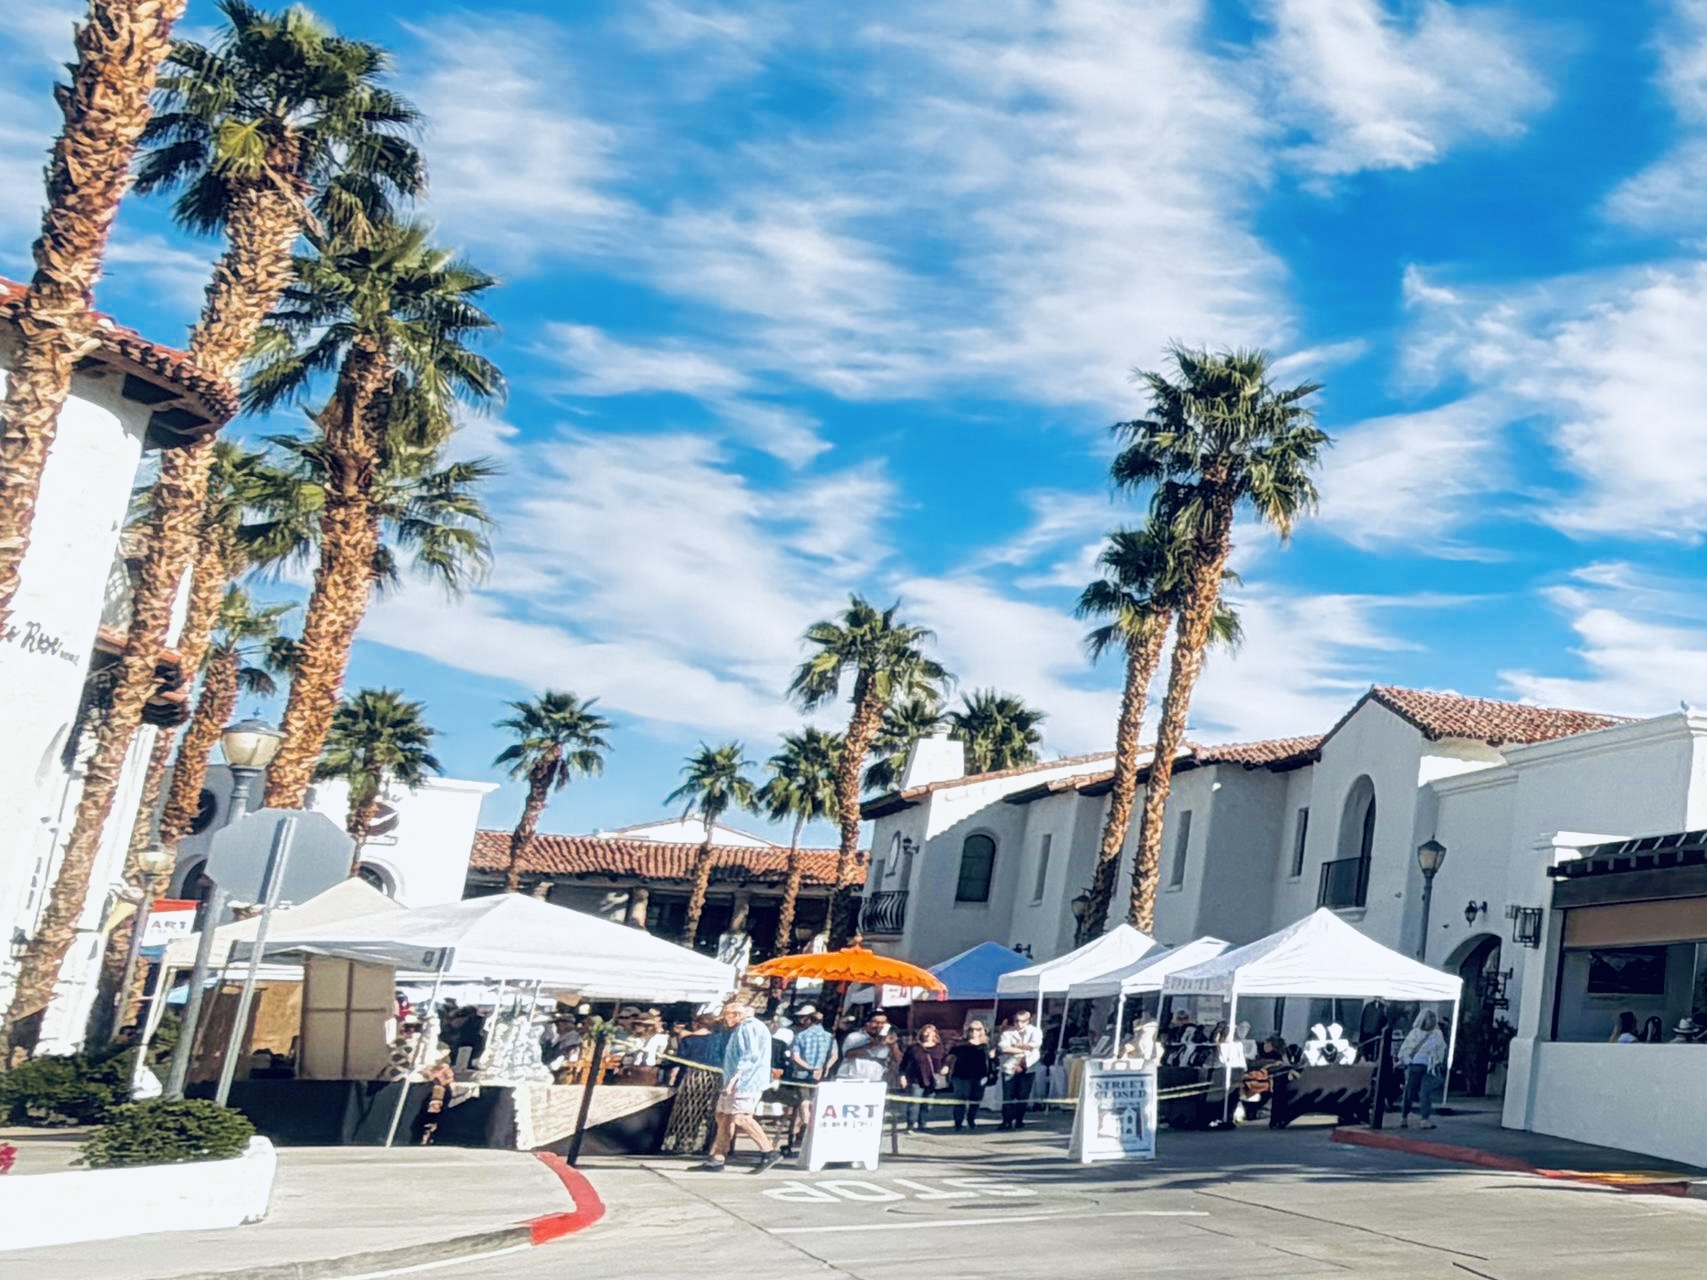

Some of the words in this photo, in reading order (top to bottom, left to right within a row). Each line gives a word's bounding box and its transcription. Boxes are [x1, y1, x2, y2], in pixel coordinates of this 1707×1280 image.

[1096, 1079, 1144, 1090] STREET
[1094, 1090, 1147, 1100] CLOSED
[822, 1104, 880, 1119] ART
[762, 1177, 1039, 1203] STOP
